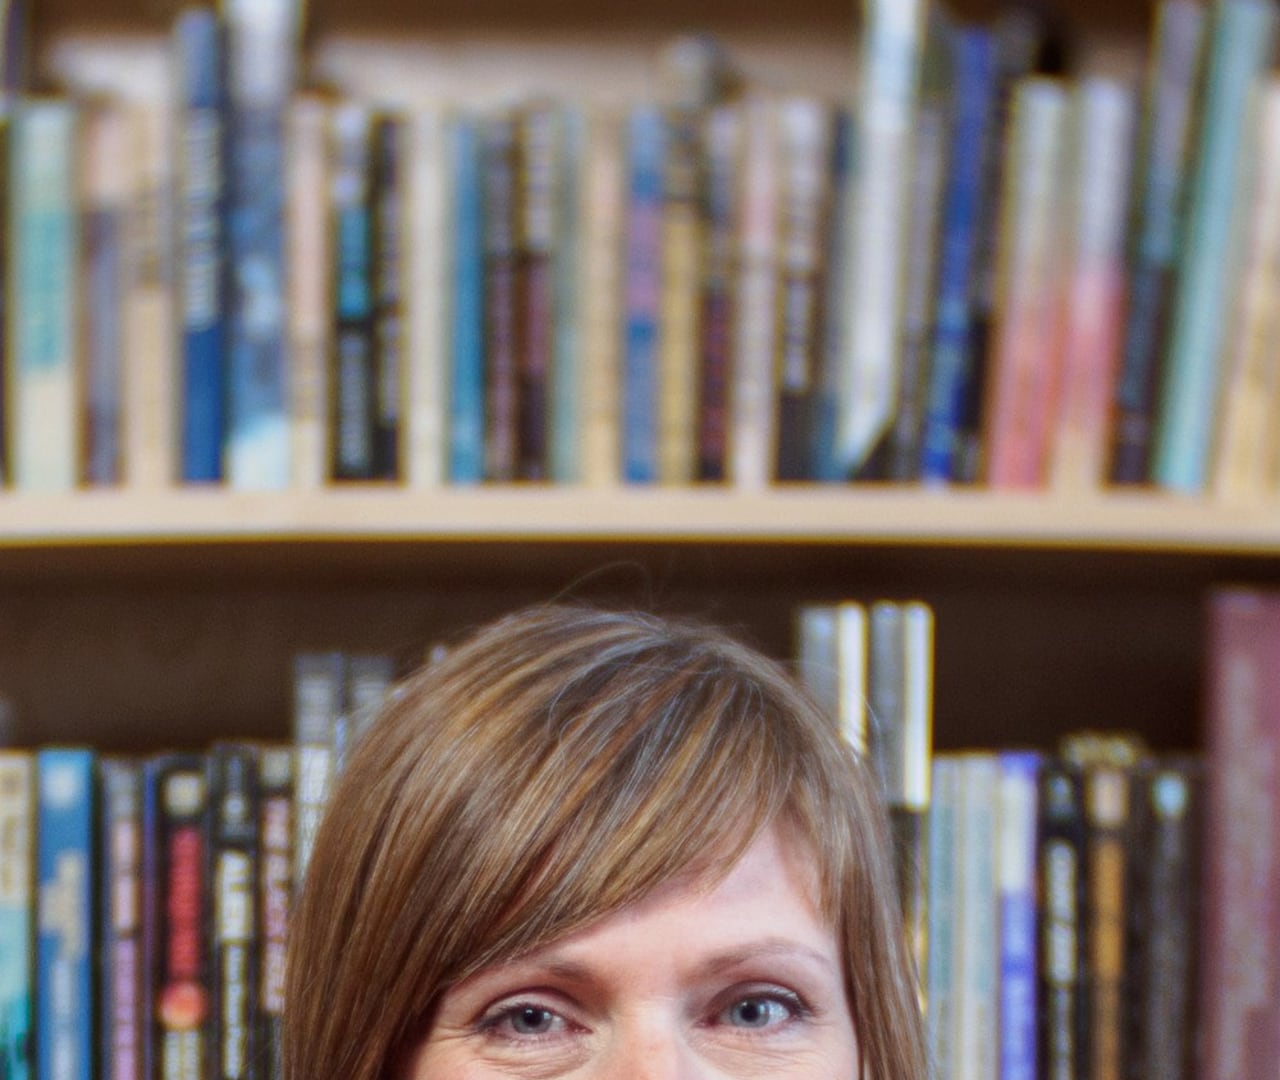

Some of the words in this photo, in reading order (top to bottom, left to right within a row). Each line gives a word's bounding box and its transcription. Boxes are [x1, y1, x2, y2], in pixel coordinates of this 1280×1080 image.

[219, 851, 247, 939] ALIEN
[265, 852, 288, 938] BLACK
[226, 983, 243, 1026] Dean
[224, 1026, 243, 1080] Foster
